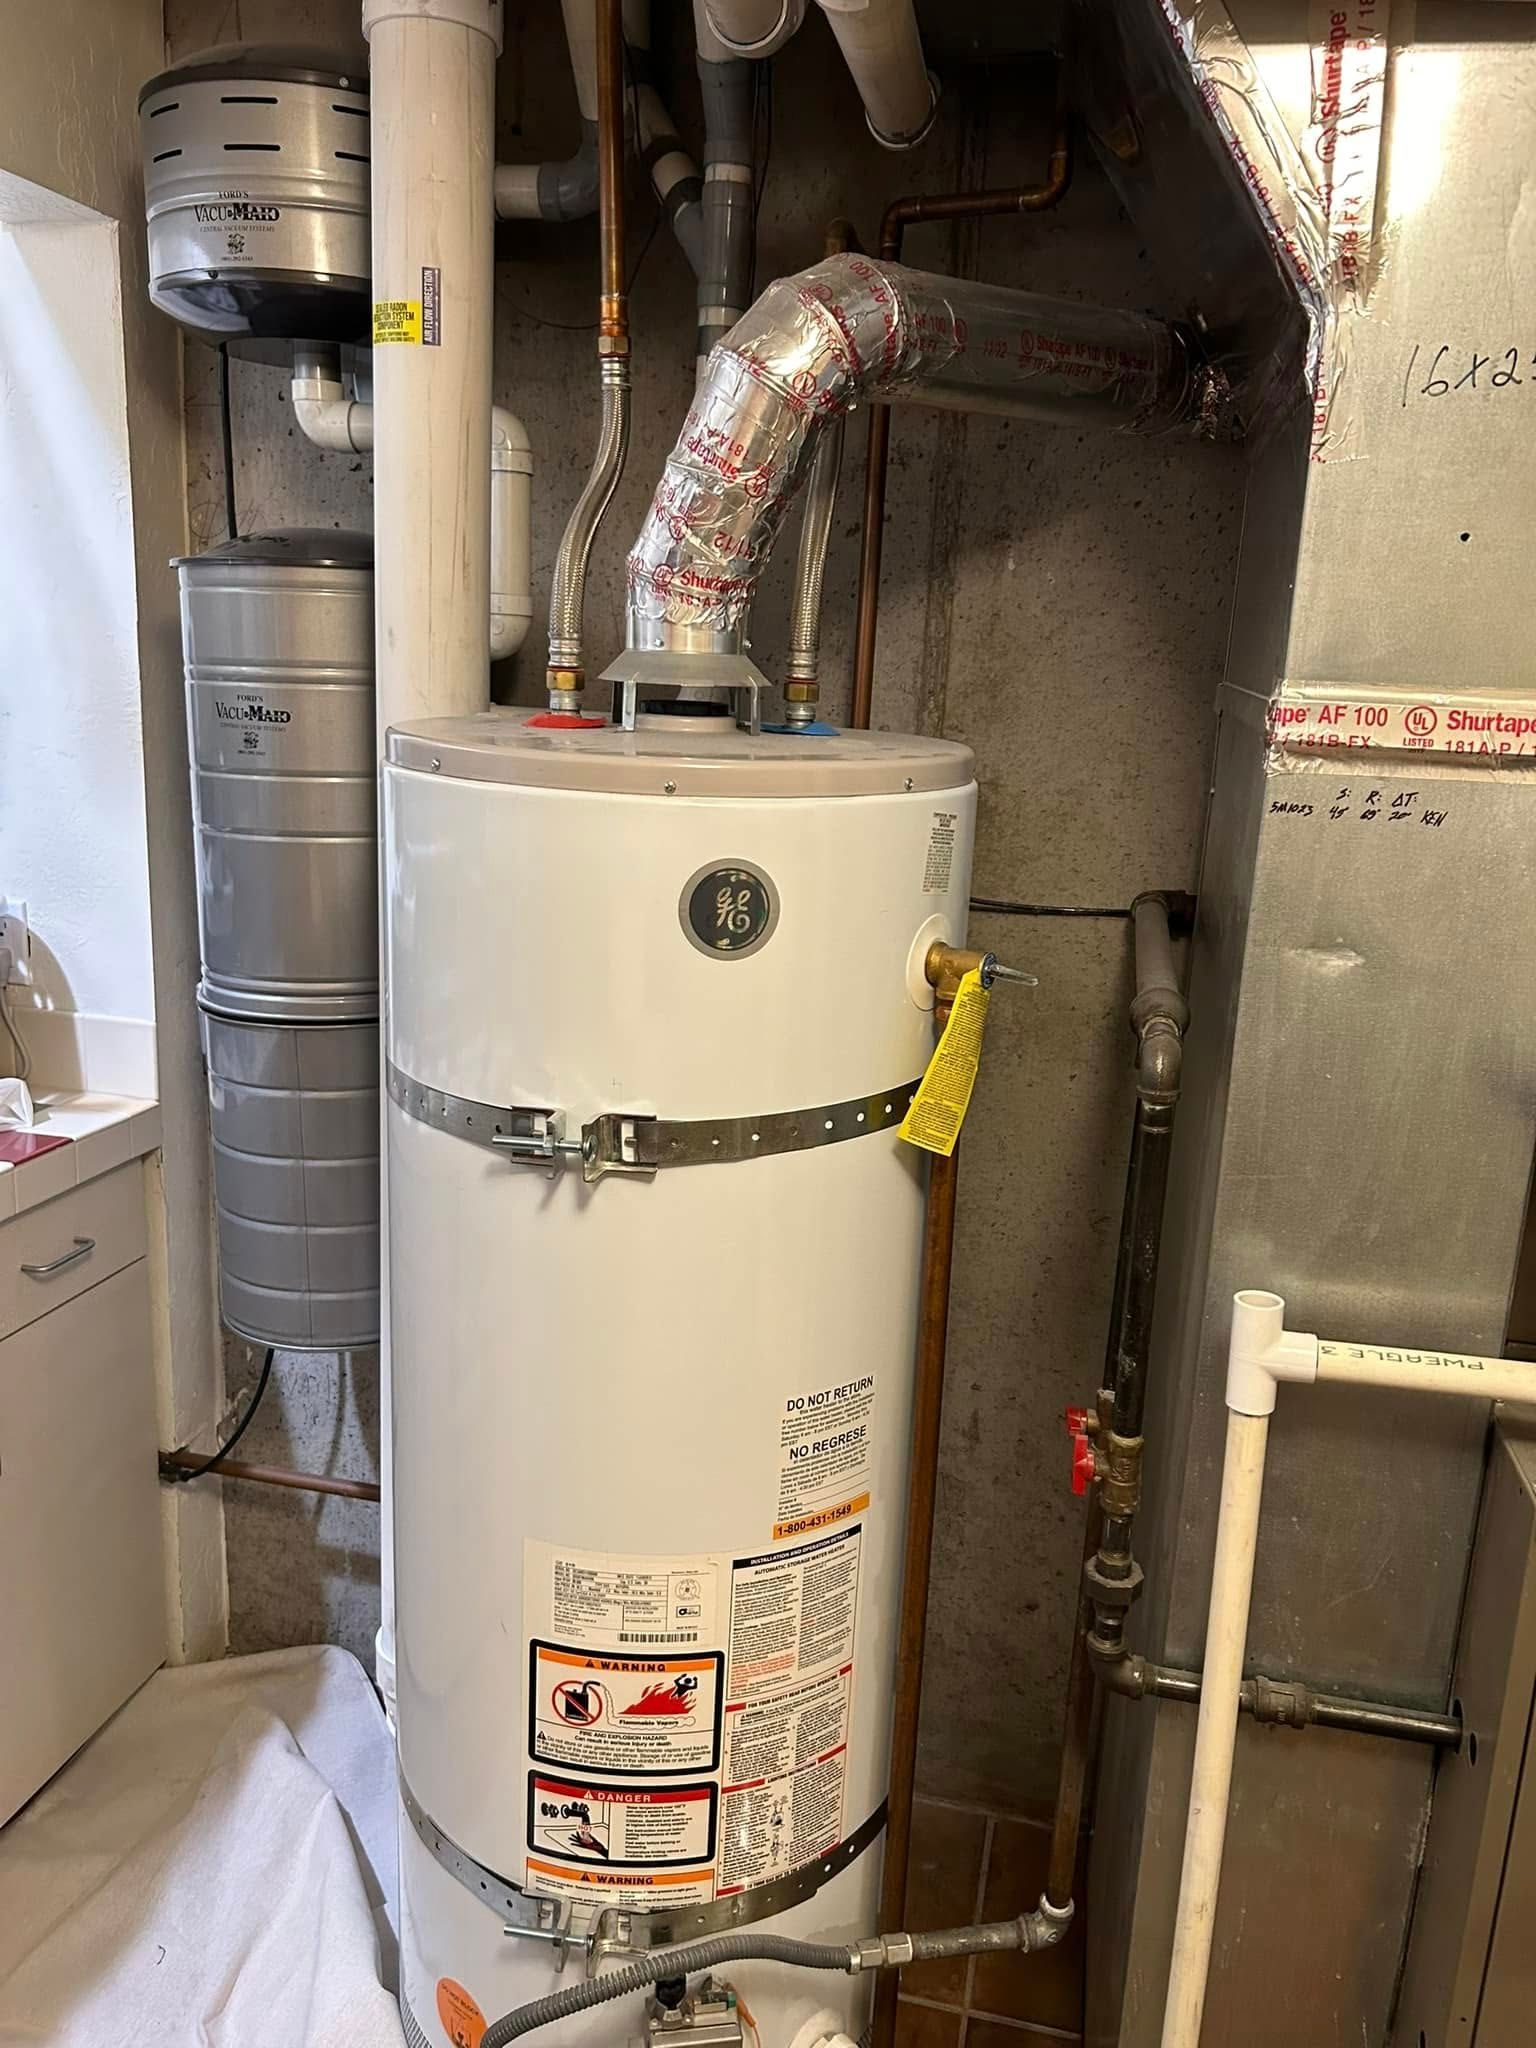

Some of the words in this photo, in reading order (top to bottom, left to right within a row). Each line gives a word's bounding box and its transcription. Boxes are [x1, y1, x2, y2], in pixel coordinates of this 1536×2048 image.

[423, 270, 434, 308] DIRECTION
[392, 311, 415, 321] SYSTEM
[423, 309, 434, 329] FLOW
[423, 331, 434, 343] AIR
[1318, 705, 1347, 724] AF
[1354, 706, 1389, 726] 100
[1402, 738, 1434, 748] LISTED
[787, 1397, 805, 1412] DO
[807, 1390, 832, 1408] NOT
[833, 1375, 874, 1401] RETURN
[789, 1445, 809, 1460] NO
[812, 1424, 867, 1454] REGRESE
[777, 1504, 852, 1536] 1-800-431-1549
[600, 1661, 667, 1673] WARNING
[597, 1791, 652, 1803] DANGER
[578, 1824, 593, 1832] HOT
[597, 1875, 654, 1886] WARNING
